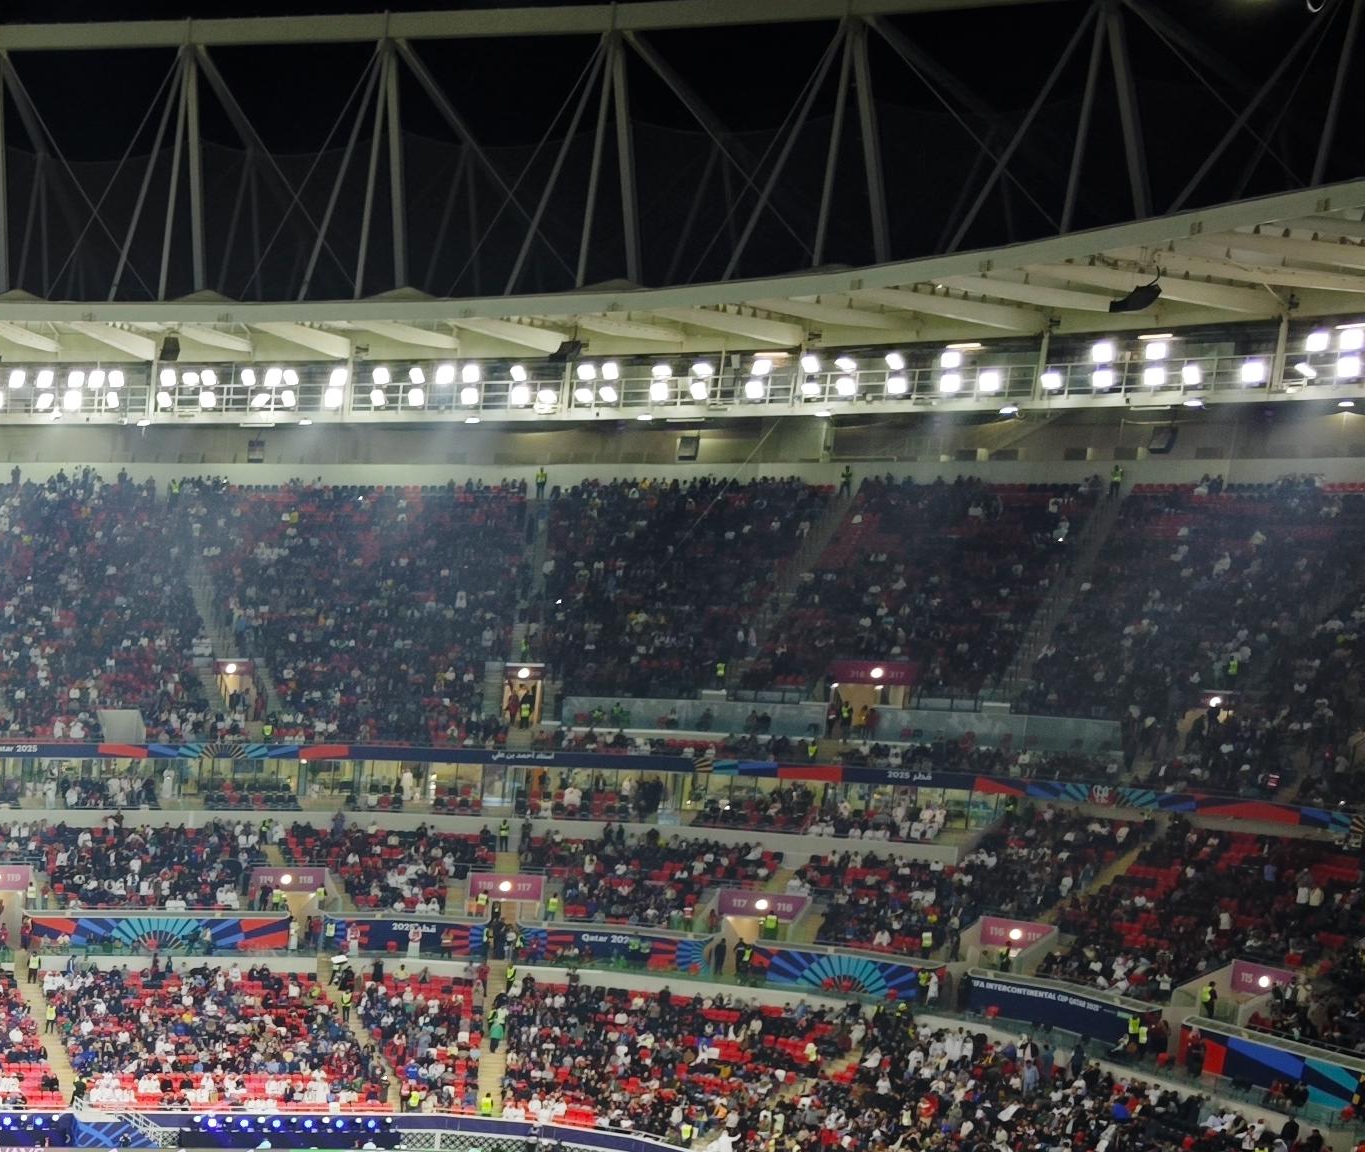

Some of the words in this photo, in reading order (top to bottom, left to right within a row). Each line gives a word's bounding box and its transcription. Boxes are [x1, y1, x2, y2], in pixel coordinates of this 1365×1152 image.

[16, 744, 38, 753] 2025
[516, 882, 532, 892] 117
[731, 899, 748, 908] 117
[392, 922, 417, 931] 2025
[581, 933, 608, 943] Qatar
